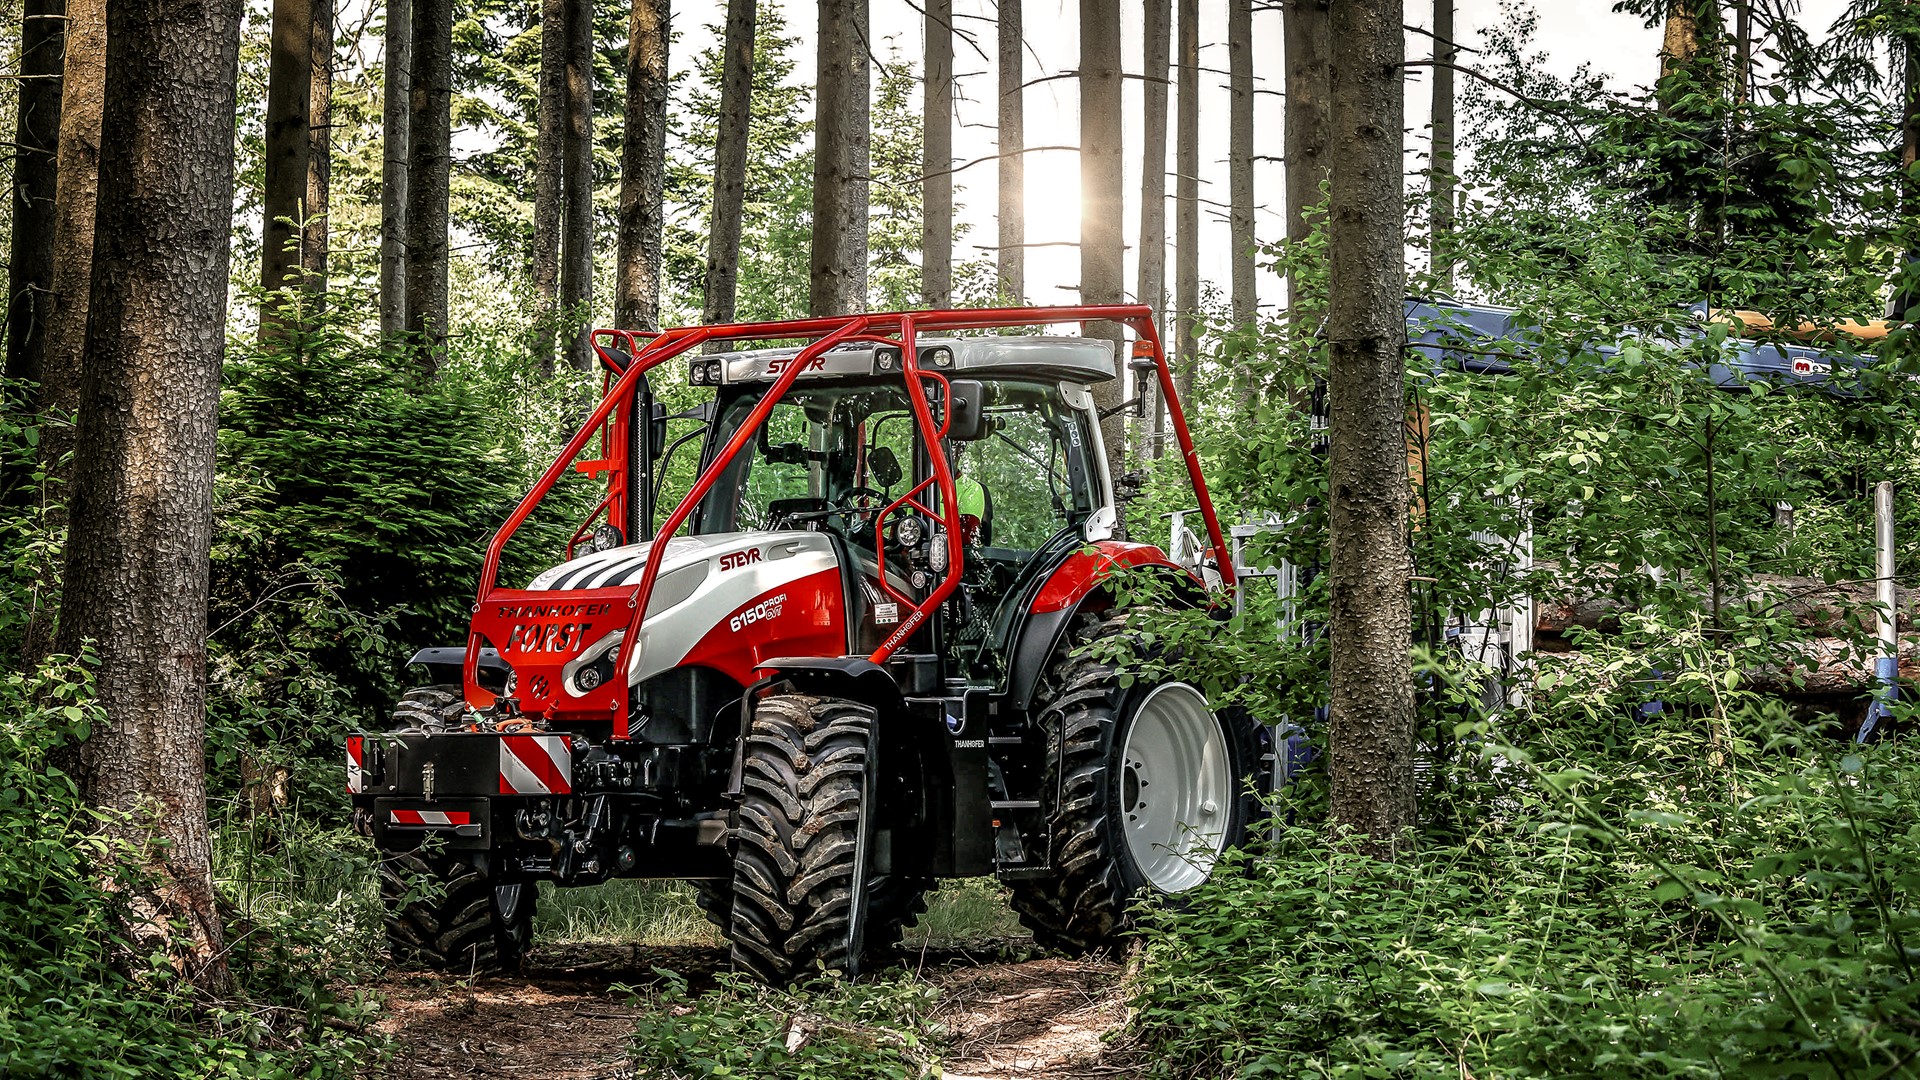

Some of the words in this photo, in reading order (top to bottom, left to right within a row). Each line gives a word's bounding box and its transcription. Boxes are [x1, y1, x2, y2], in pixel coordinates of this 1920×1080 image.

[766, 357, 825, 375] STR
[719, 547, 762, 572] STEYR
[497, 604, 612, 618] THANHOFER
[730, 603, 766, 632] 6150
[763, 593, 788, 609] PROFI
[504, 622, 593, 653] FORST
[883, 610, 924, 650] THANHOFER
[954, 739, 985, 748] THANHOFER
